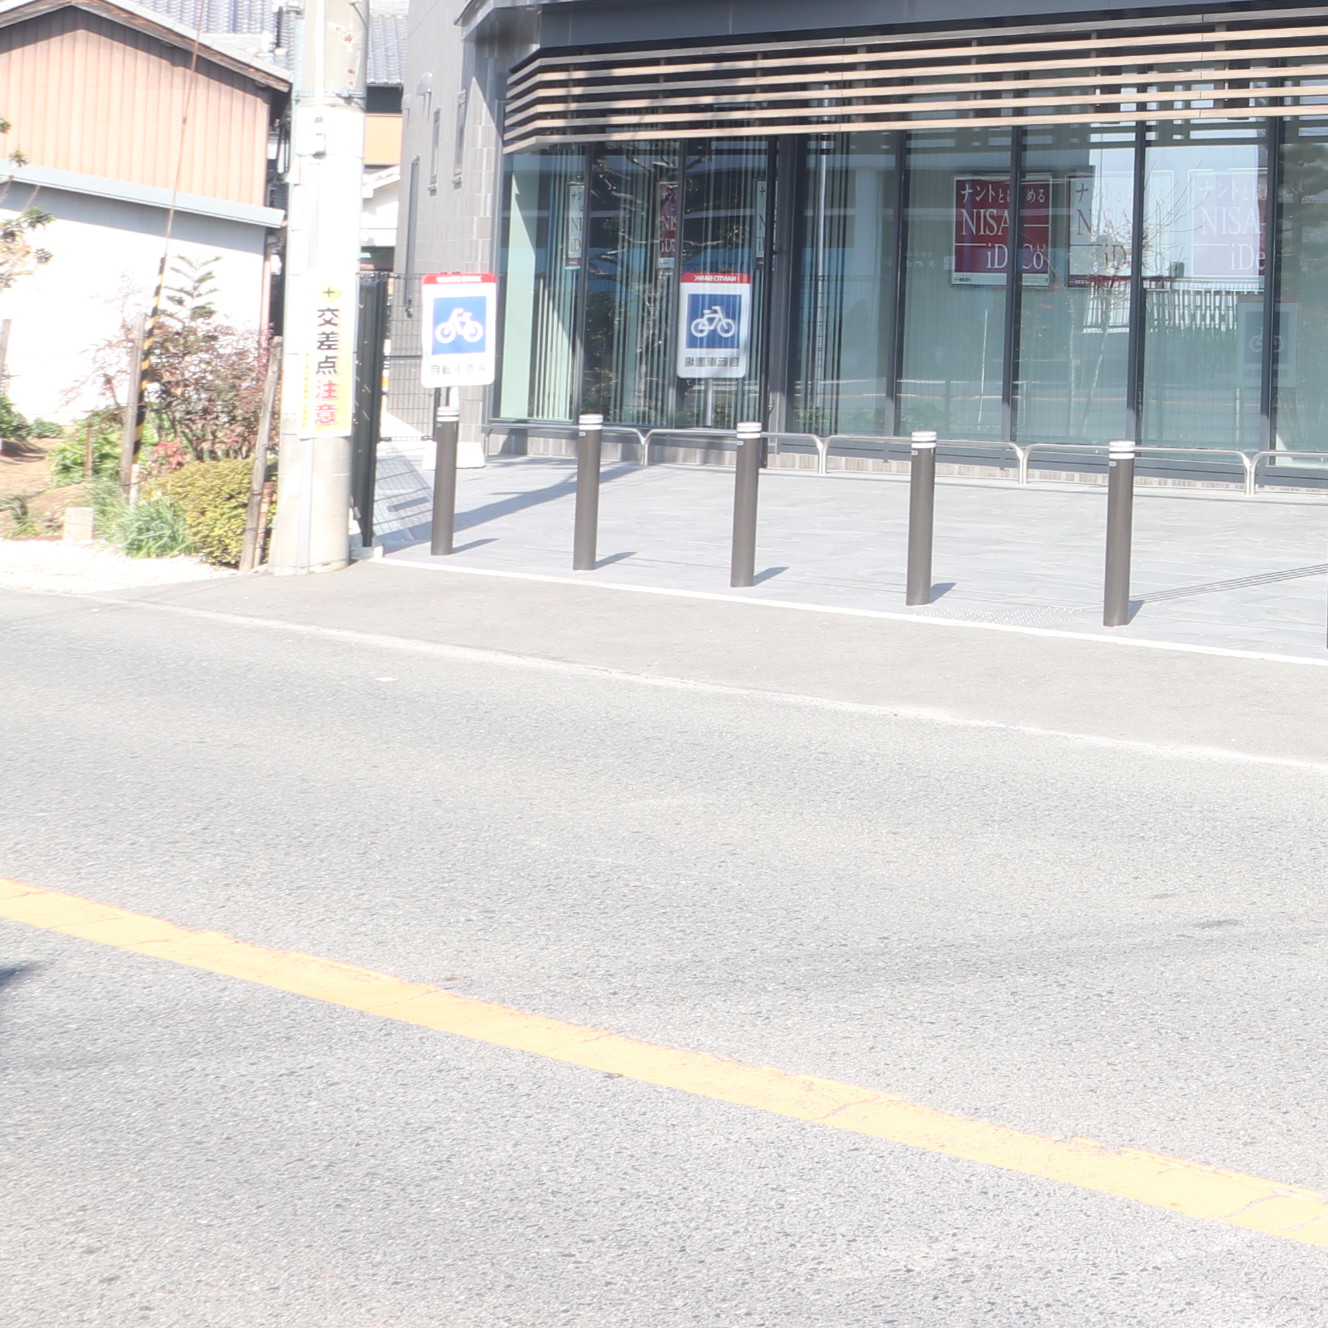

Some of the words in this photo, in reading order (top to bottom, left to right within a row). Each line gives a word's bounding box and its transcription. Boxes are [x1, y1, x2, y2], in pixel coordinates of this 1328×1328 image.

[986, 243, 1044, 270] iDCo
[314, 307, 340, 426] 交差点注意
